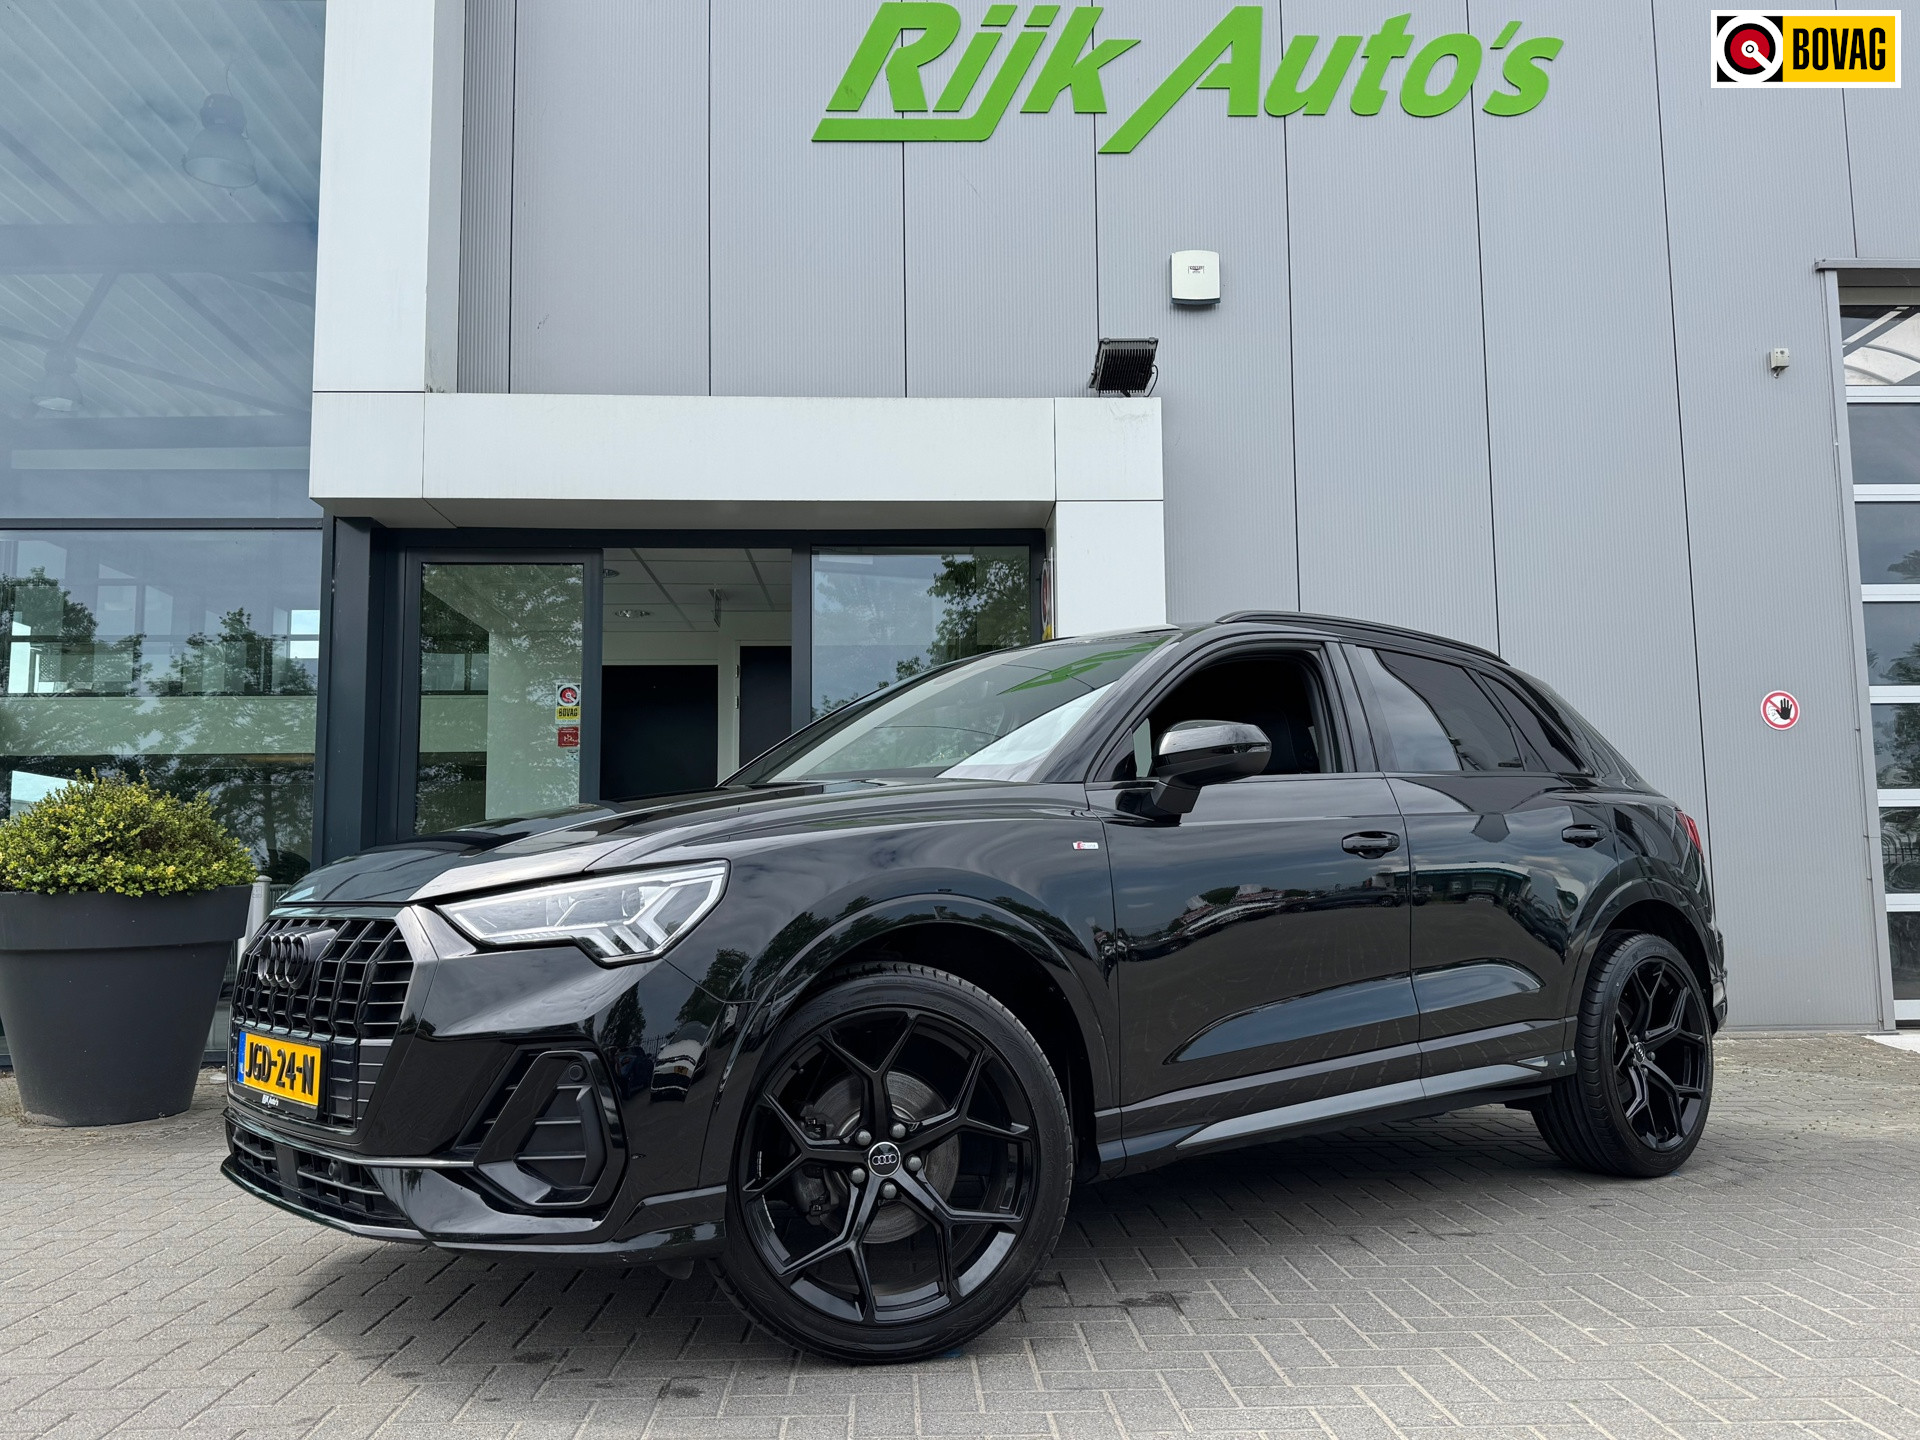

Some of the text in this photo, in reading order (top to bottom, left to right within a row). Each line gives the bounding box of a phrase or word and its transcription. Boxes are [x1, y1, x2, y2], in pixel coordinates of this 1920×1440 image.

[812, 2, 1564, 154] Rijk Auto's
[558, 708, 578, 717] BOVAG
[245, 1042, 315, 1096] JGD-24-N
